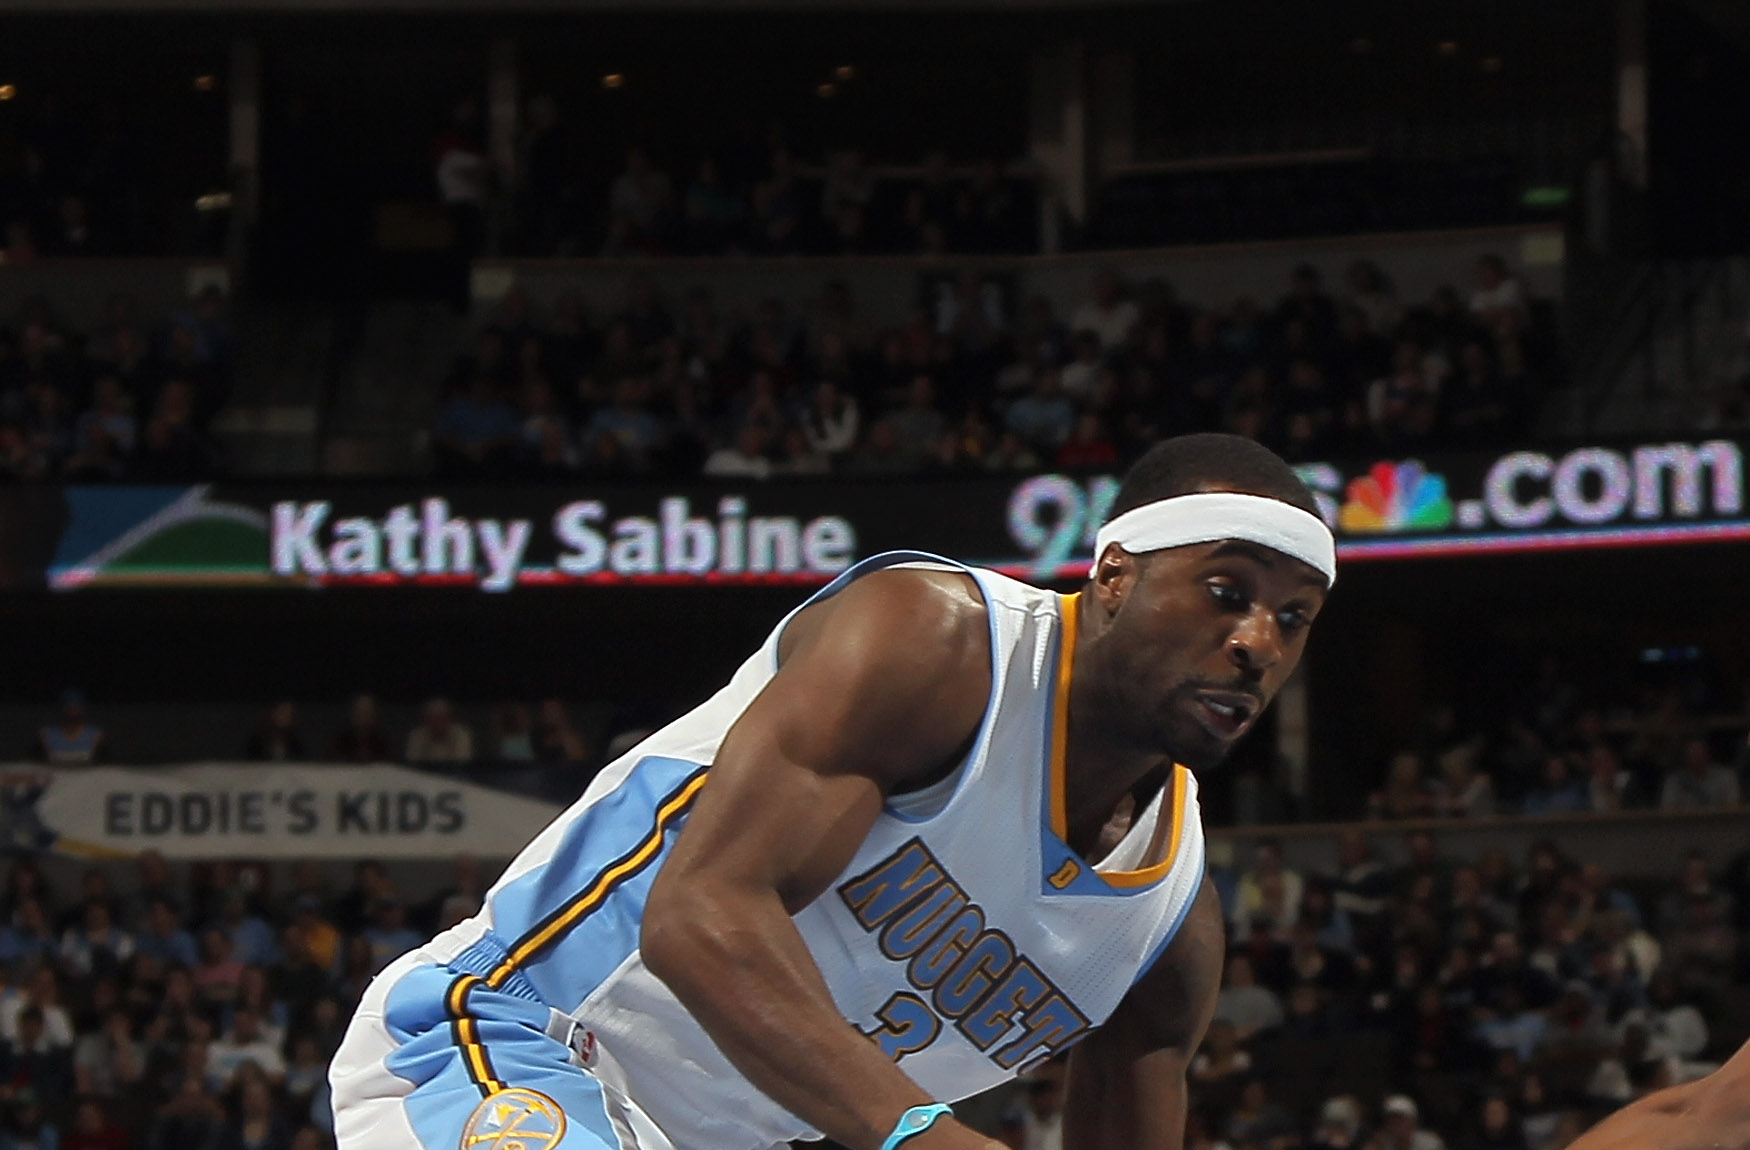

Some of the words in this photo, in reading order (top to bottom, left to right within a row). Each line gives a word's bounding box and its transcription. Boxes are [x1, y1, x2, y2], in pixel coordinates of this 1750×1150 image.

[270, 497, 532, 592] Kathy
[554, 497, 855, 576] Sabine
[104, 791, 320, 836] EDDIE'S
[336, 791, 466, 836] KIDS
[836, 836, 1092, 1076] NUGGET
